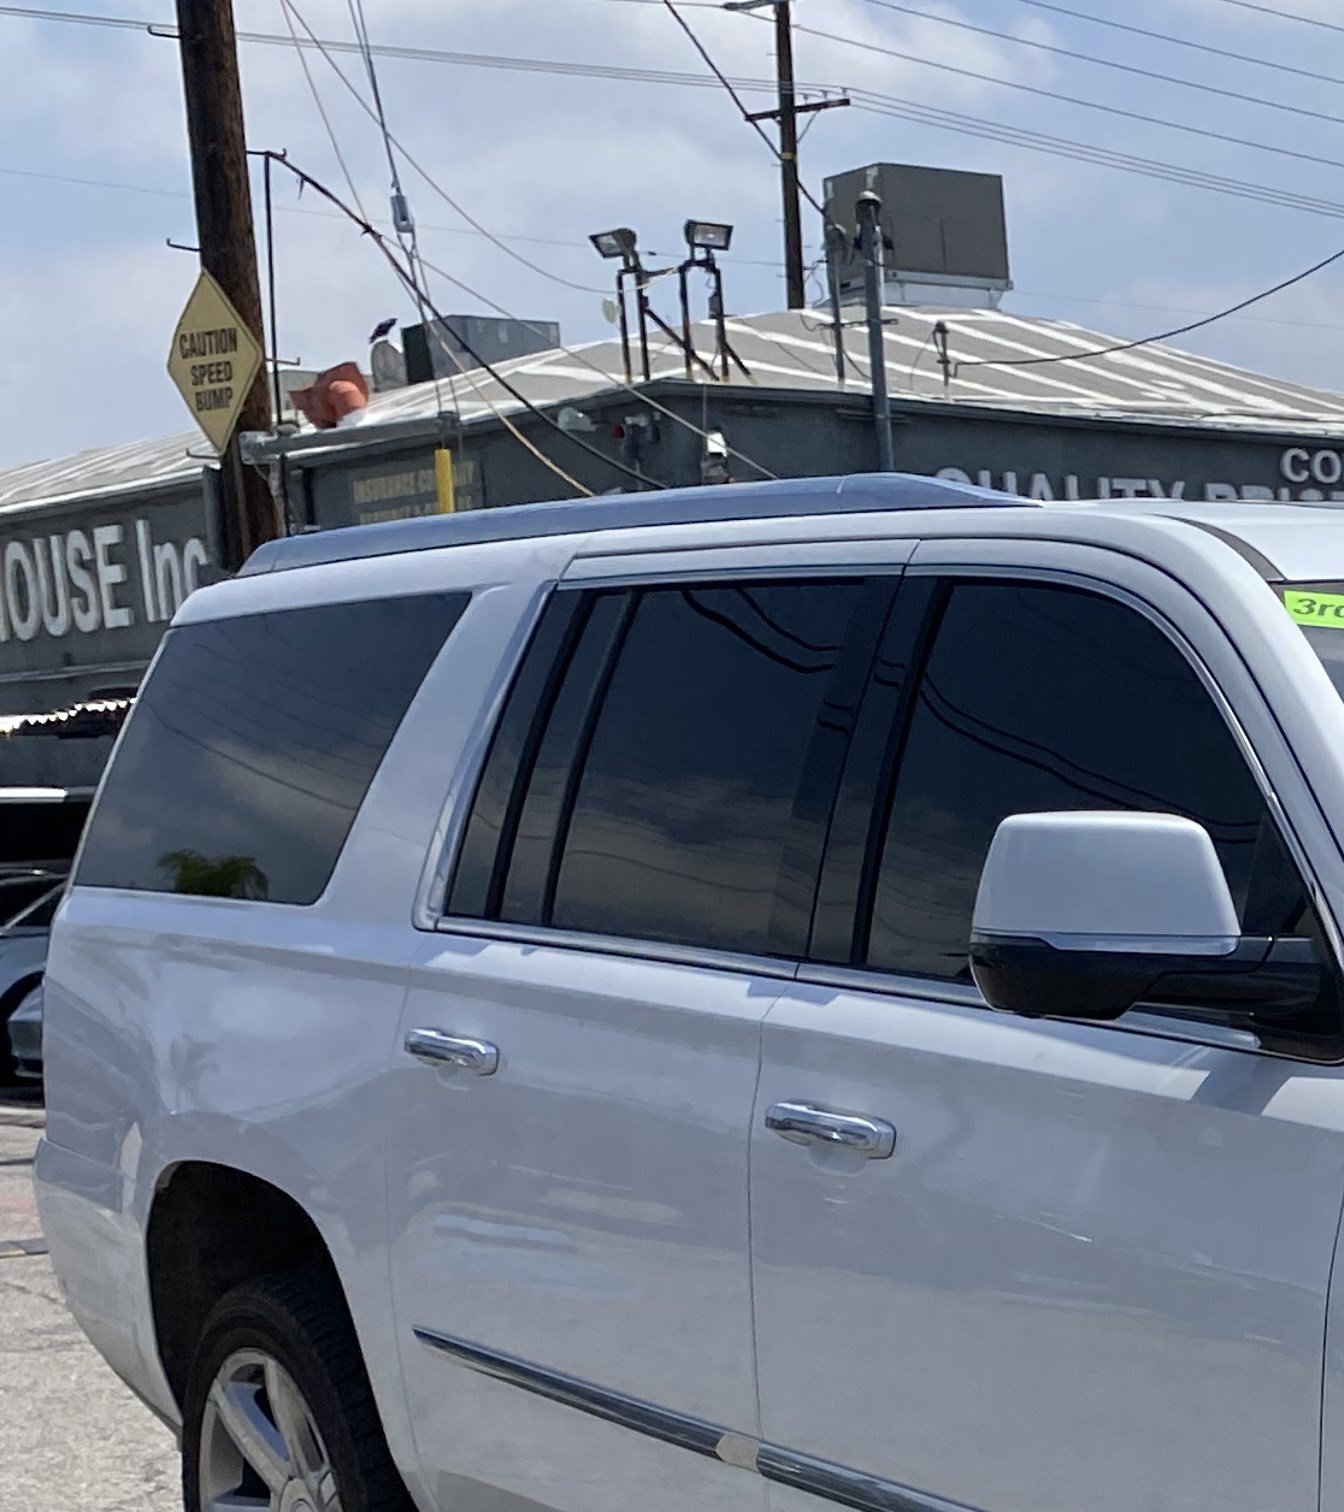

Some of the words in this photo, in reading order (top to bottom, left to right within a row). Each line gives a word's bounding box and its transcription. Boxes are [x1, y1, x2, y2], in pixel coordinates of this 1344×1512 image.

[180, 328, 237, 359] CAUTION
[191, 361, 232, 386] SPEED
[195, 387, 233, 411] BUMP
